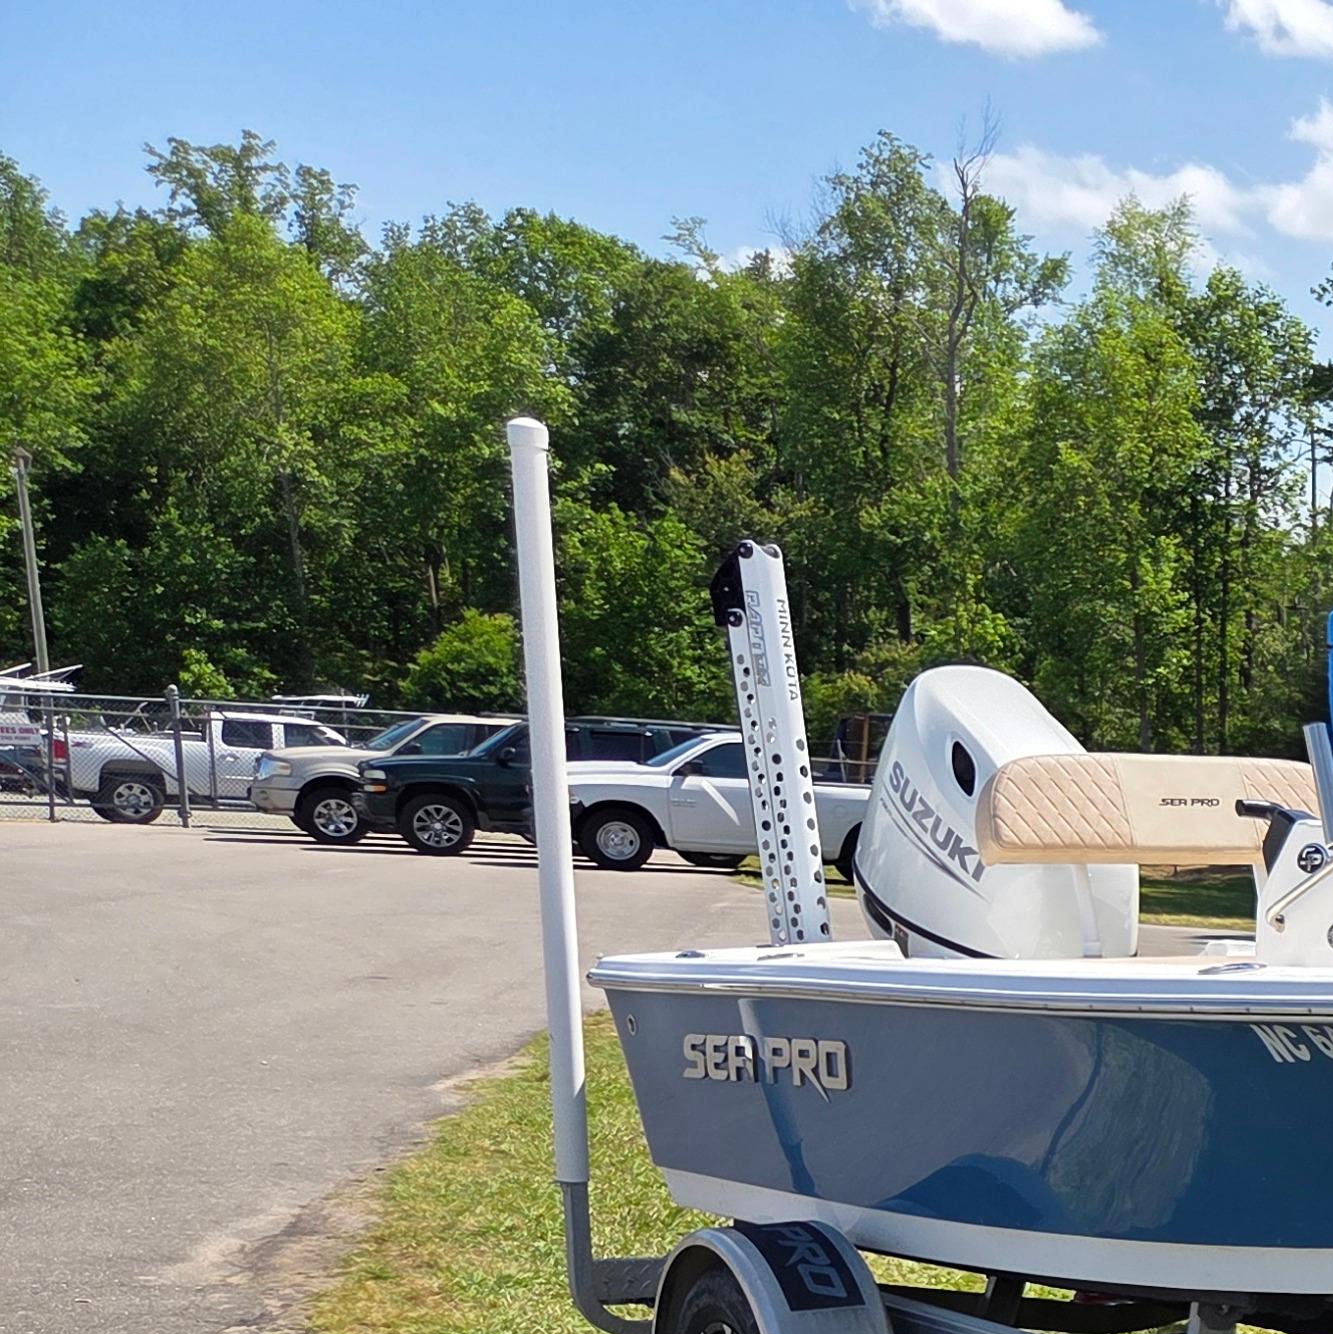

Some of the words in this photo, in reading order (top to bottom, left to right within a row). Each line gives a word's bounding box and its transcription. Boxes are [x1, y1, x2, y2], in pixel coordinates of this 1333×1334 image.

[776, 599, 792, 648] MINN
[784, 653, 799, 701] KOTA
[889, 760, 986, 883] SUZUKI
[1159, 798, 1188, 807] SEA
[1190, 798, 1220, 808] PRO
[683, 1033, 757, 1083] SEA
[764, 1037, 850, 1103] PRO
[1250, 1024, 1311, 1063] NC
[762, 1226, 848, 1298] PRO
